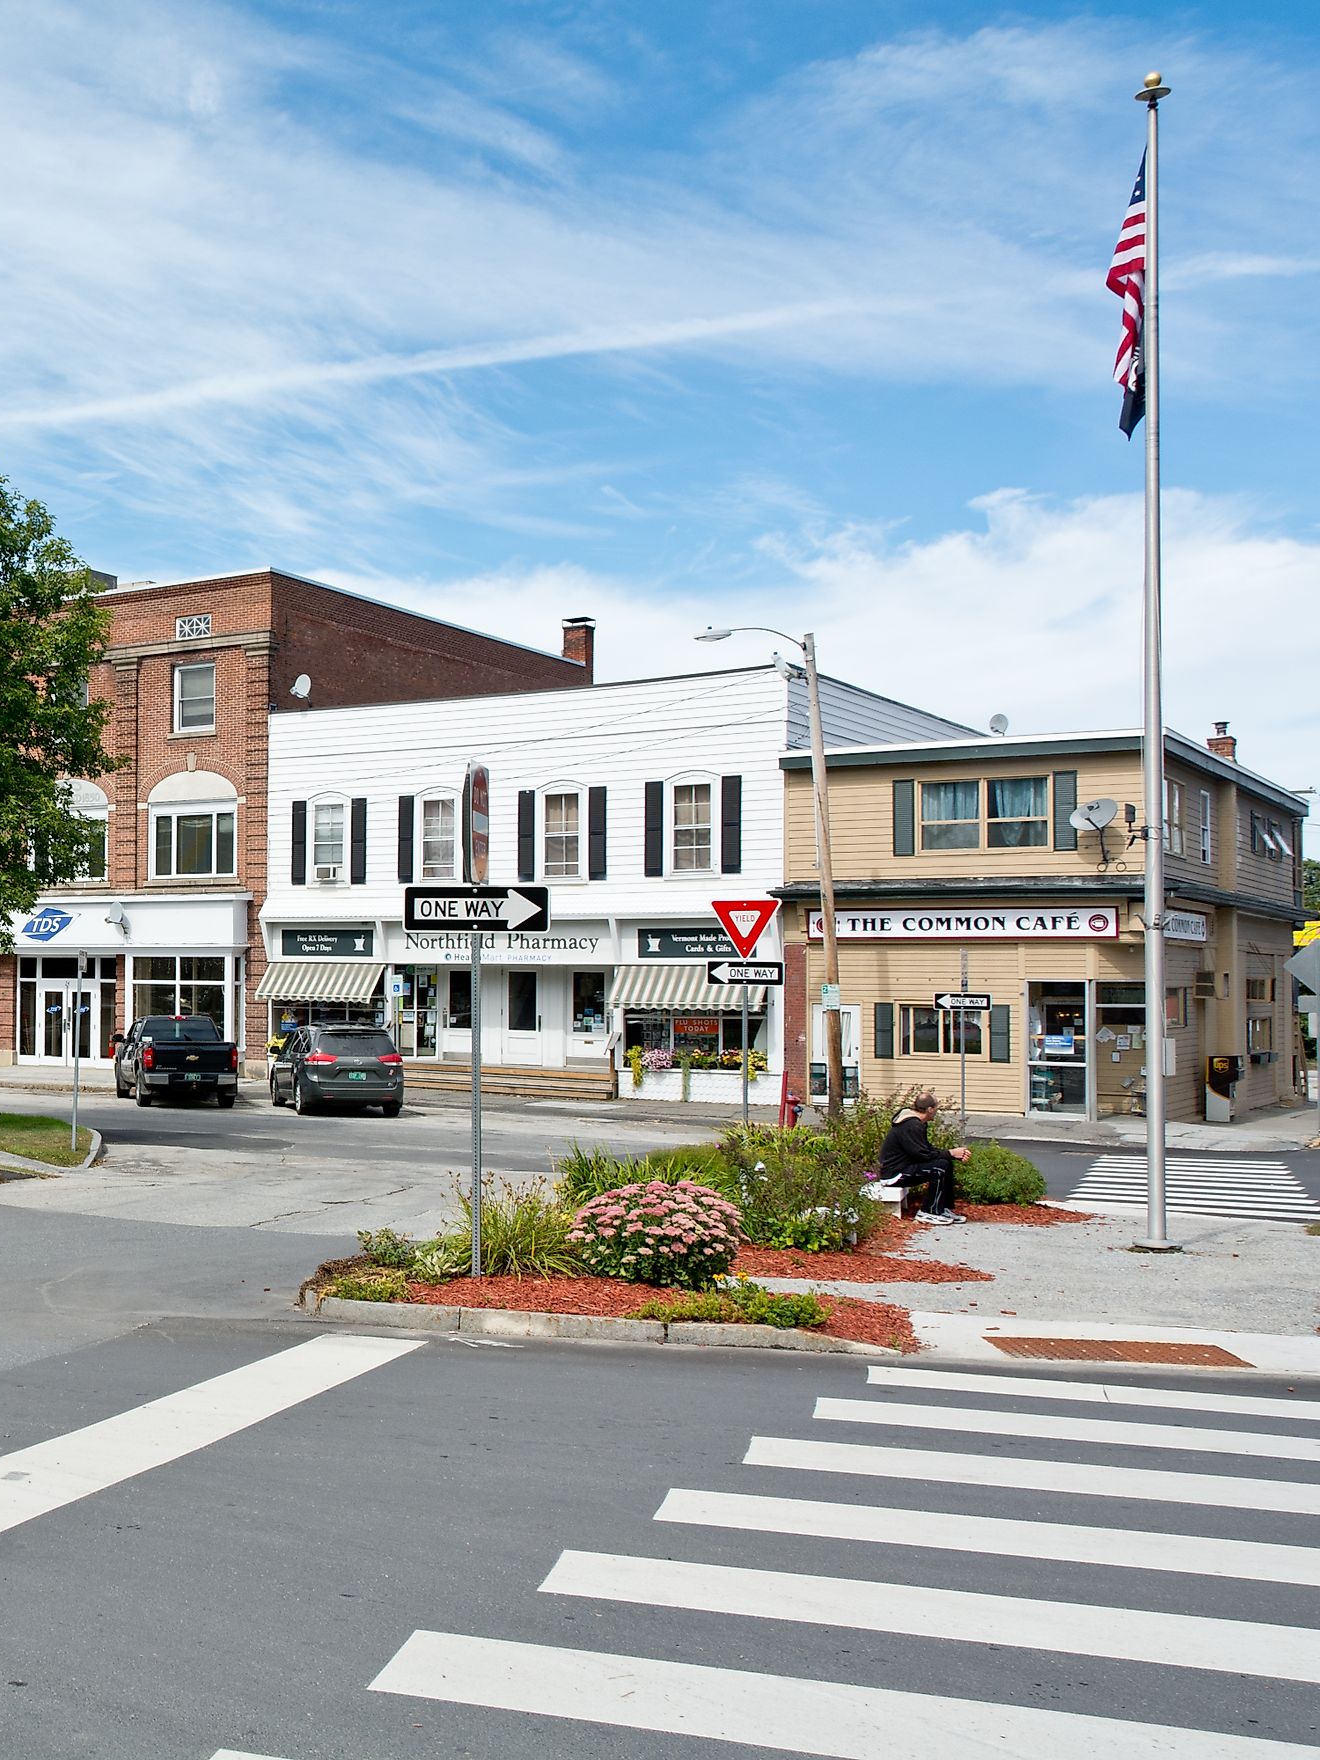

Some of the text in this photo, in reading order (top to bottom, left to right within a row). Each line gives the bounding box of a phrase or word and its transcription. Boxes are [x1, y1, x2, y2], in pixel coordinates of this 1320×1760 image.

[420, 900, 505, 918] ONE WAY
[734, 914, 756, 922] YIELD
[846, 911, 1081, 932] THE COMMON CAFÉ
[32, 917, 62, 932] TDS
[297, 934, 338, 943] Free RX Delivery
[405, 932, 600, 953] Northfild Pharmacy
[671, 934, 698, 942] Vermont
[699, 934, 717, 942] Made
[301, 944, 315, 953] Open
[320, 944, 332, 953] Days
[685, 944, 732, 952] Cards & Gifts
[729, 968, 776, 979] ONE WAY
[968, 998, 985, 1006] WAY
